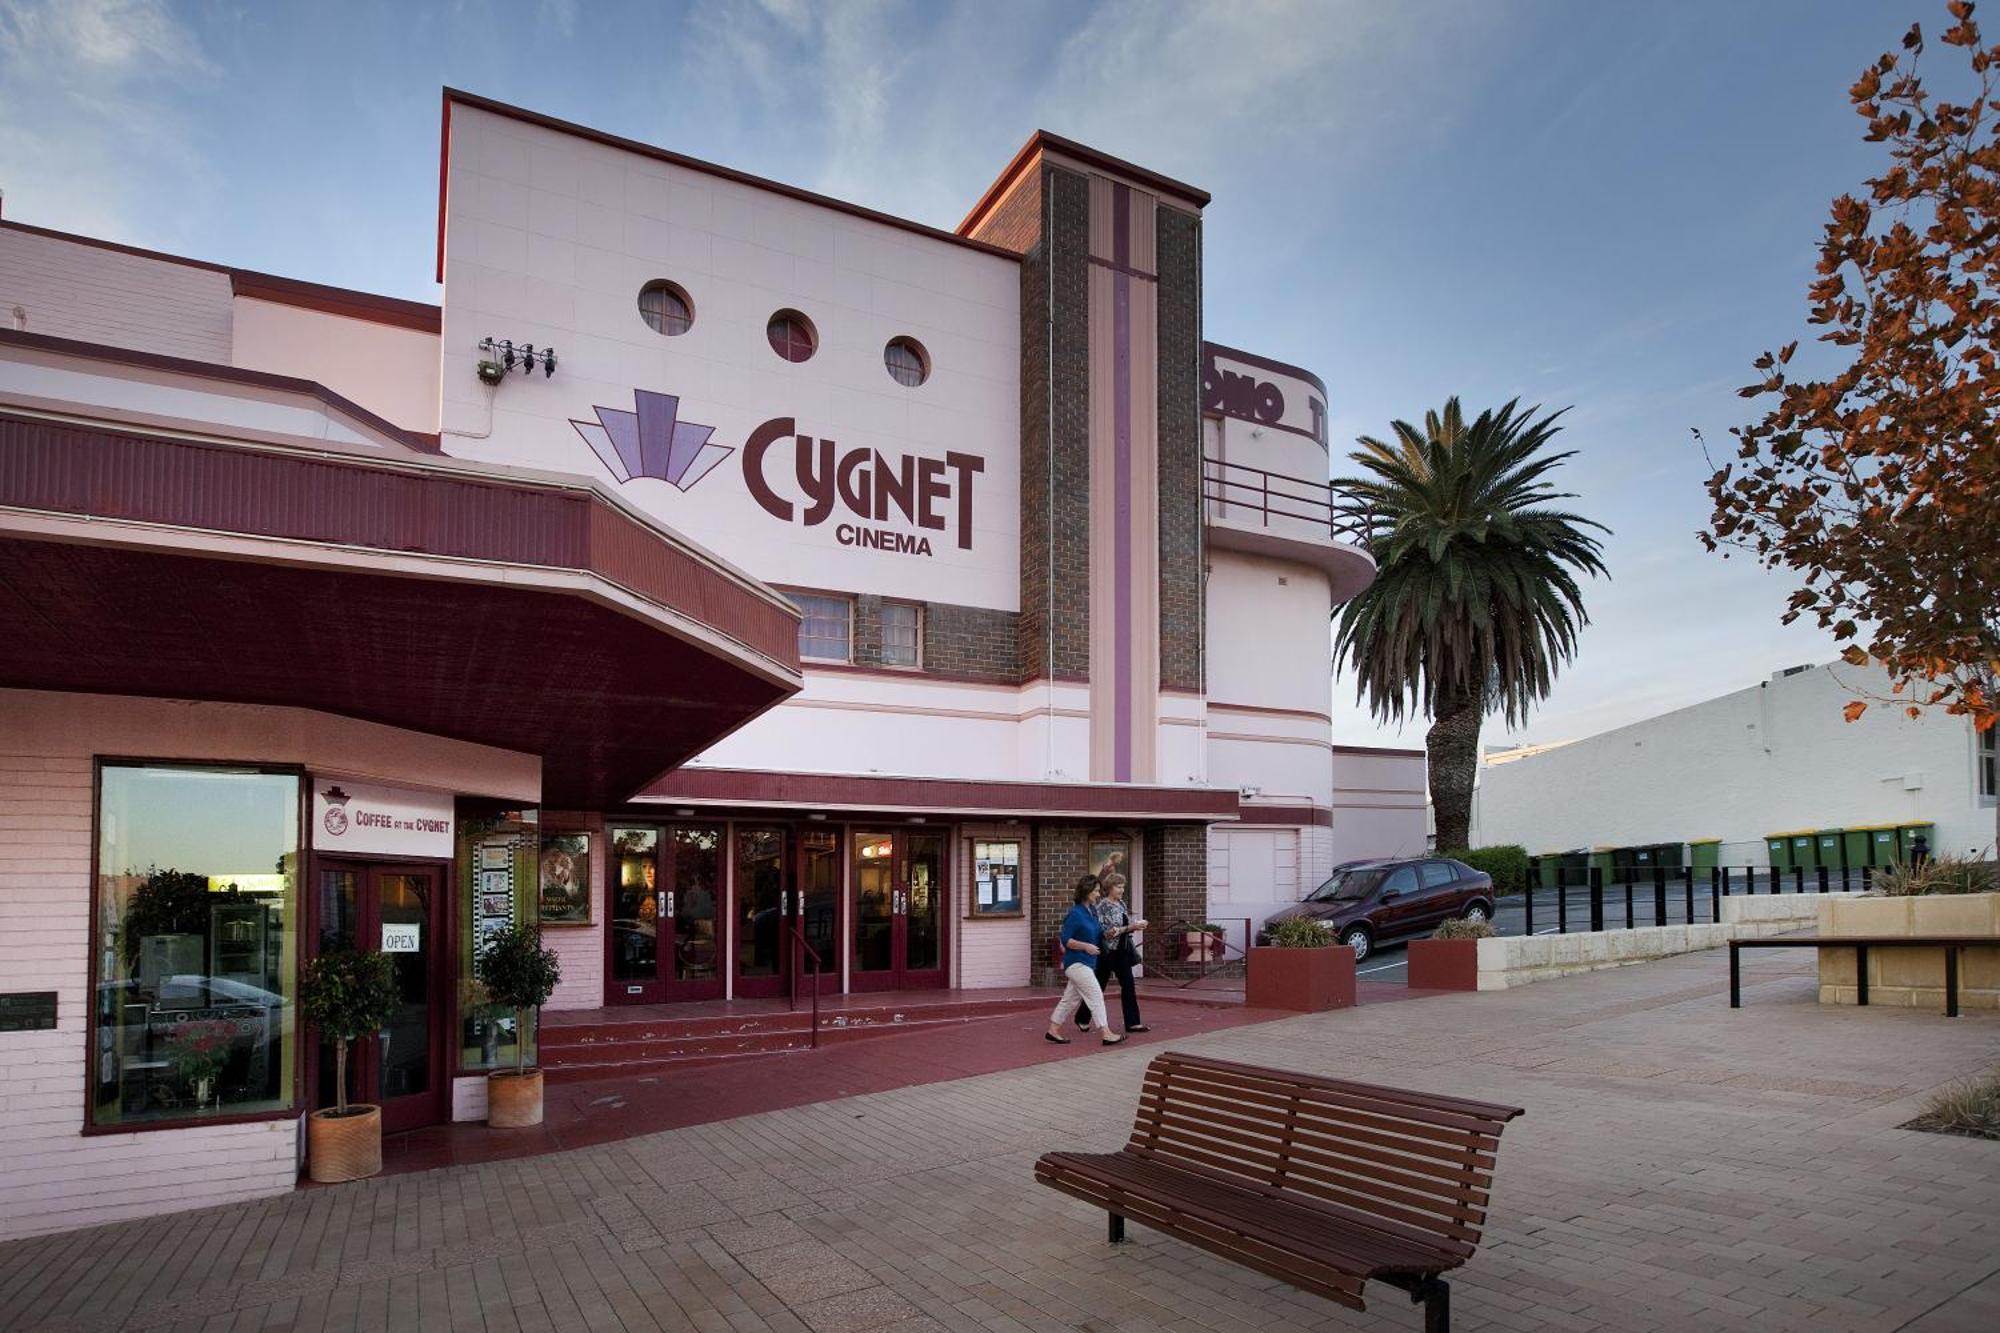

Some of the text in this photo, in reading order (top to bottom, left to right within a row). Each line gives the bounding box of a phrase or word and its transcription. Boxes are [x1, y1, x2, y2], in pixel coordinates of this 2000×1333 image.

[1202, 355, 1285, 425] OMO
[742, 416, 985, 550] CYGNET
[835, 523, 933, 557] CINEMA
[356, 810, 450, 834] COFFEE AT THE CYGNET
[386, 935, 415, 949] OPEN
